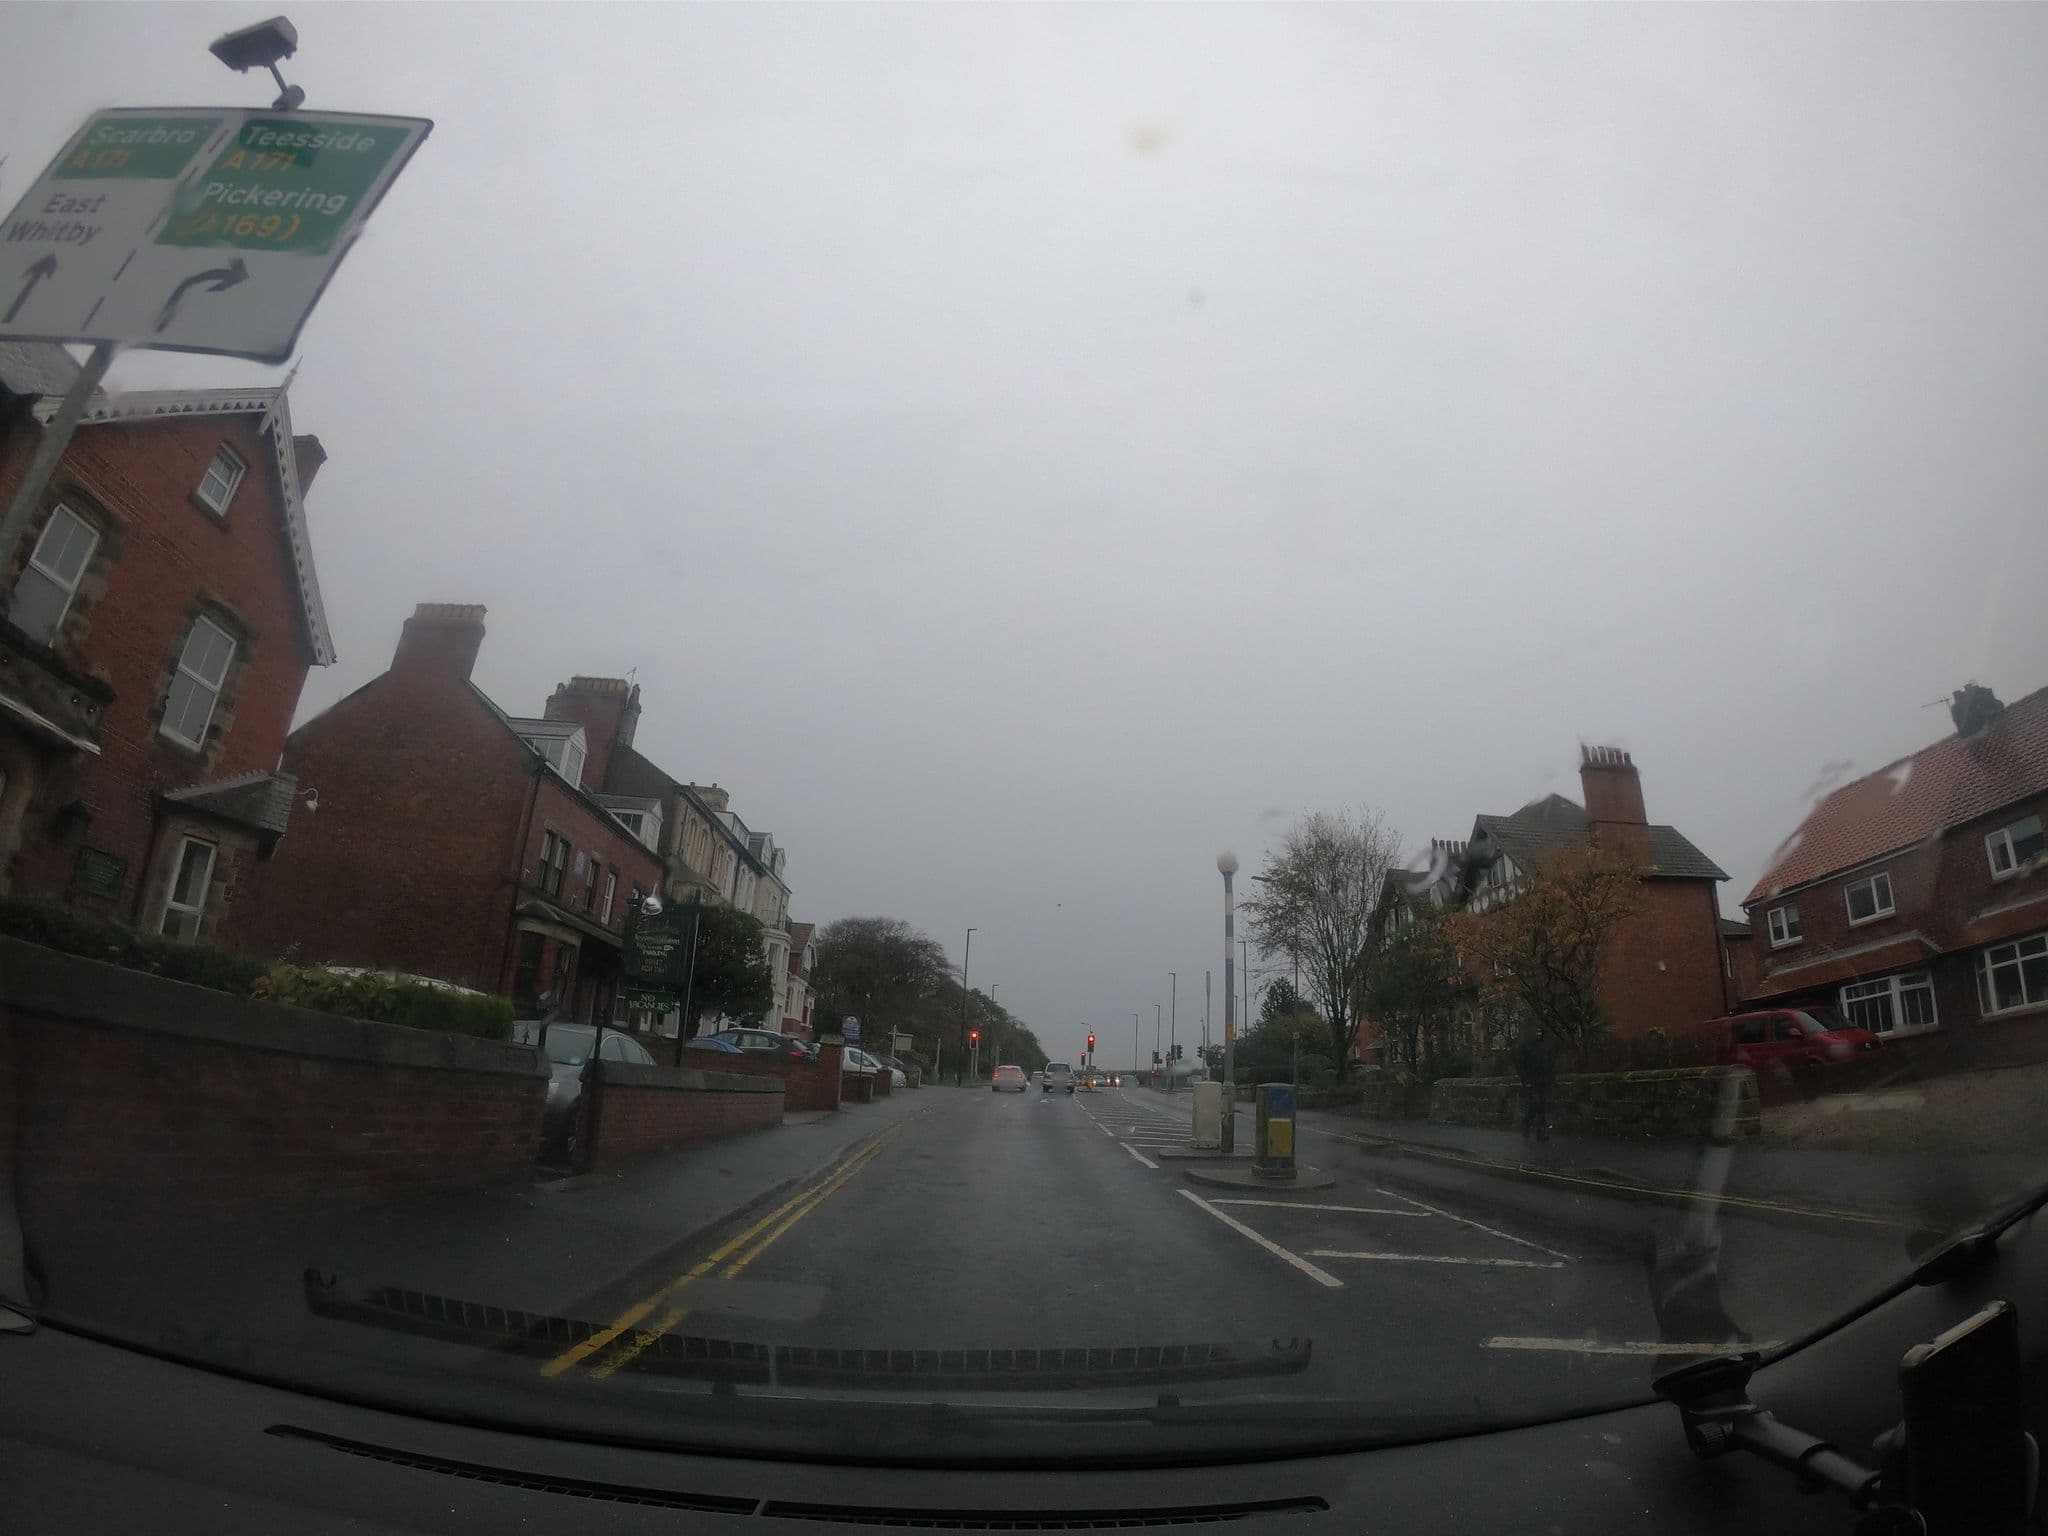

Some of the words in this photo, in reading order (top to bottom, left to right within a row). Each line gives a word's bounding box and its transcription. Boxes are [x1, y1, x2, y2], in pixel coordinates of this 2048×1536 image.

[244, 126, 376, 152] Teesside
[42, 193, 106, 214] East
[203, 182, 349, 215] Pickering
[7, 221, 102, 247] Whitby
[641, 994, 656, 1002] NO
